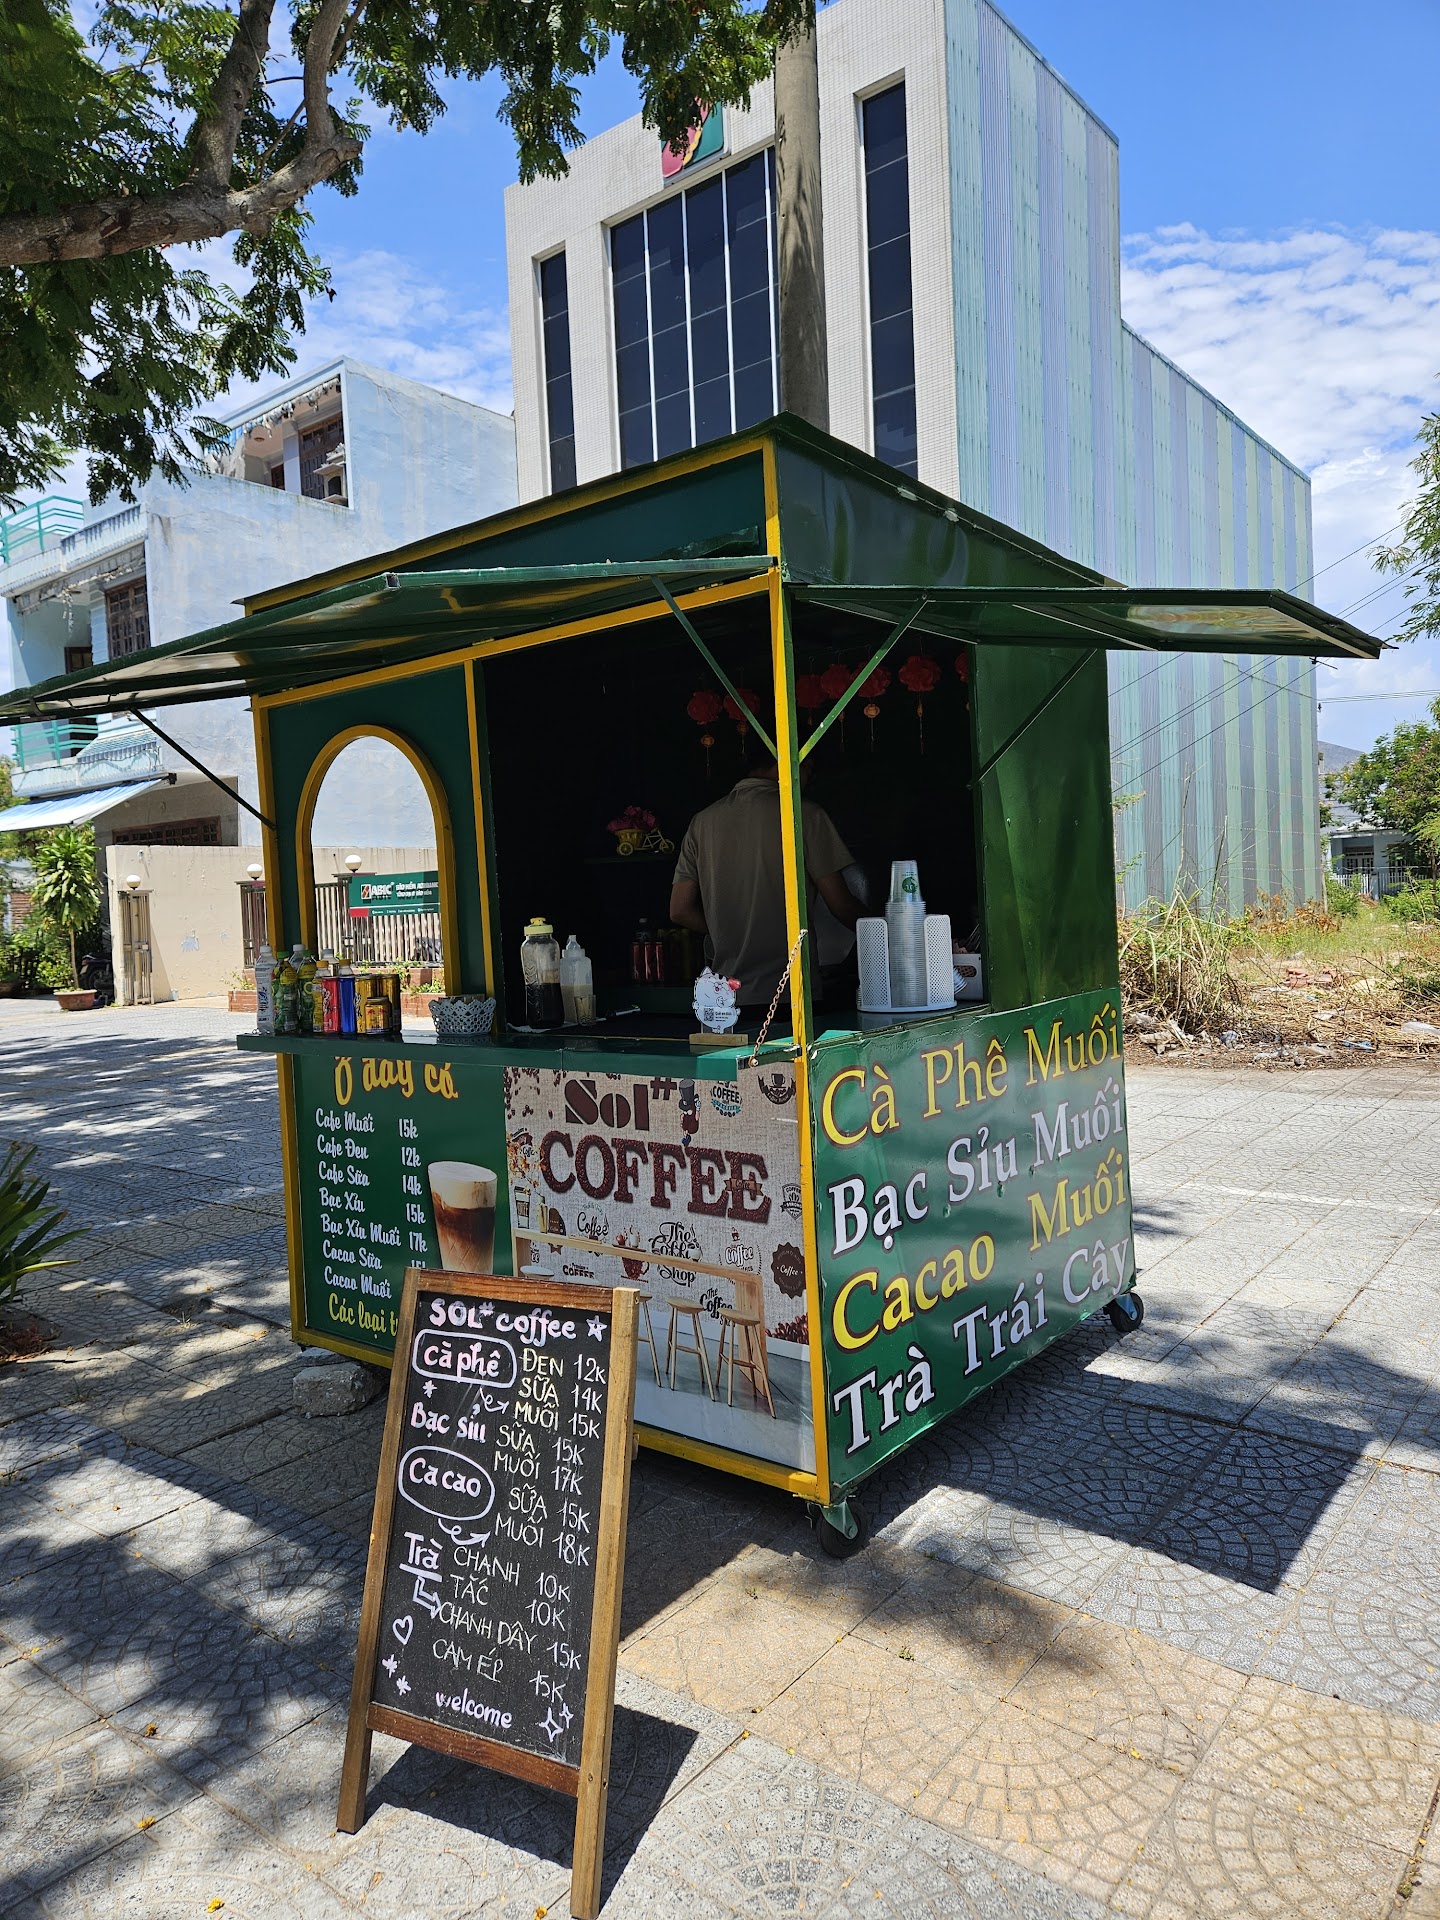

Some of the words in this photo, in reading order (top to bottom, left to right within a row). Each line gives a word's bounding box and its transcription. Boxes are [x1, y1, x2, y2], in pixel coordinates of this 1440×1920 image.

[822, 1066, 898, 1147] Cà
[922, 1039, 1008, 1118] Phê
[1024, 1003, 1122, 1086] Muối
[712, 1085, 740, 1104] COFFEE
[315, 1108, 342, 1132] Cafe
[344, 1111, 375, 1133] Muối
[399, 1118, 419, 1140] 15k
[317, 1134, 343, 1159] Cafe
[344, 1137, 369, 1160] Đen
[401, 1146, 422, 1168] 12k
[828, 1170, 928, 1256] Bạc
[947, 1126, 1018, 1204] Sỉu
[1031, 1077, 1125, 1168] Muối
[318, 1160, 345, 1185] Cafe
[347, 1164, 370, 1187] Sữa
[402, 1174, 423, 1196] 14k
[540, 1130, 772, 1224] COFFEE
[319, 1187, 342, 1212] Bạc
[344, 1191, 366, 1213] Xỉu
[405, 1202, 427, 1224] 15k
[320, 1213, 344, 1239] Bạc
[345, 1217, 368, 1240] Xỉu
[370, 1222, 402, 1247] Muối
[408, 1231, 428, 1253] 17k
[577, 1211, 609, 1237] Coffee
[659, 1221, 691, 1244] The
[322, 1239, 357, 1265] Cacao
[359, 1246, 383, 1270] Sữa
[725, 1243, 754, 1267] Coffee
[832, 1234, 997, 1350] Cacao
[1028, 1149, 1127, 1252] Muối
[324, 1265, 358, 1291] Cacao
[360, 1273, 392, 1299] Muối
[780, 1264, 799, 1278] Coffee
[328, 1292, 356, 1326] Các
[358, 1300, 387, 1340] loại
[495, 1307, 577, 1348] coffee
[423, 1341, 453, 1369] cà
[456, 1341, 500, 1383] phê
[519, 1347, 565, 1379] ĐEN
[835, 1344, 935, 1455] Trà
[953, 1273, 1048, 1376] Trái
[1062, 1238, 1130, 1304] Cây
[518, 1375, 559, 1407] SỮA
[410, 1401, 450, 1438] Bạc
[496, 1421, 536, 1454] SỮA
[508, 1483, 548, 1519] SỮA
[404, 1531, 443, 1570] Trà
[453, 1545, 521, 1586] CHANH
[439, 1601, 493, 1639] CHANH
[498, 1620, 538, 1654] DÂY
[432, 1637, 473, 1671] CAM
[435, 1687, 513, 1729] welcome
